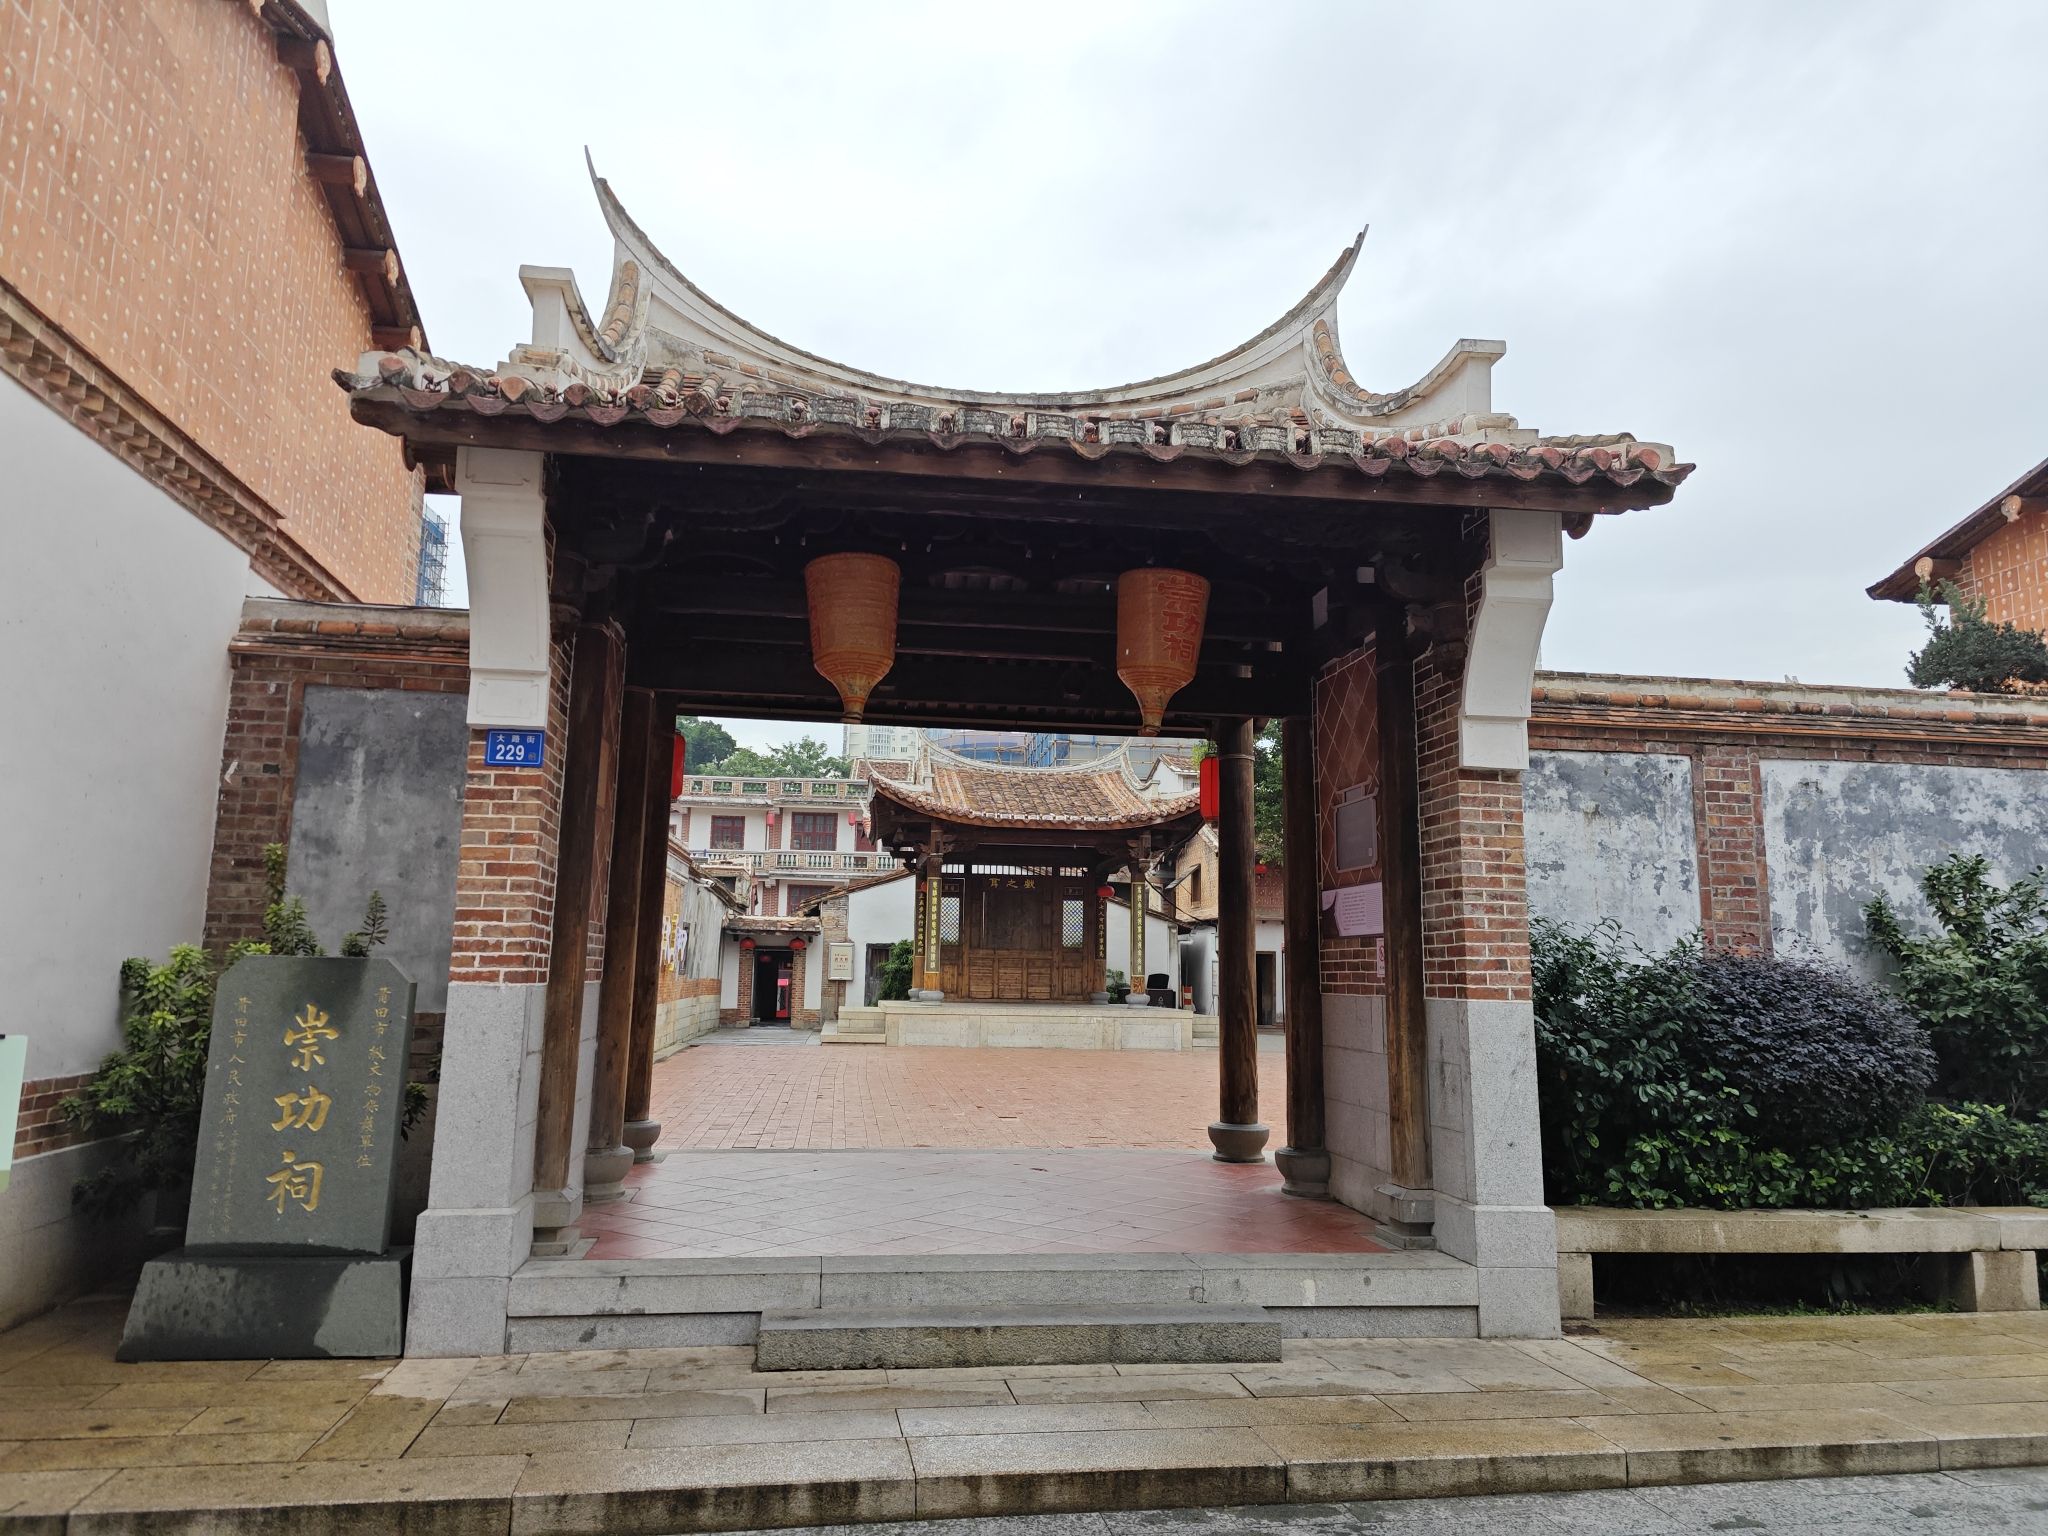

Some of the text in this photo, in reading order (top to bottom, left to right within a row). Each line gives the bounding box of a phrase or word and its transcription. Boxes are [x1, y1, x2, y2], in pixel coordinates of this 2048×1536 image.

[1157, 574, 1204, 664] 崇功祠
[496, 744, 525, 761] 229
[220, 996, 252, 1125] 莆田市人民政府
[265, 1003, 340, 1215] 崇功祠
